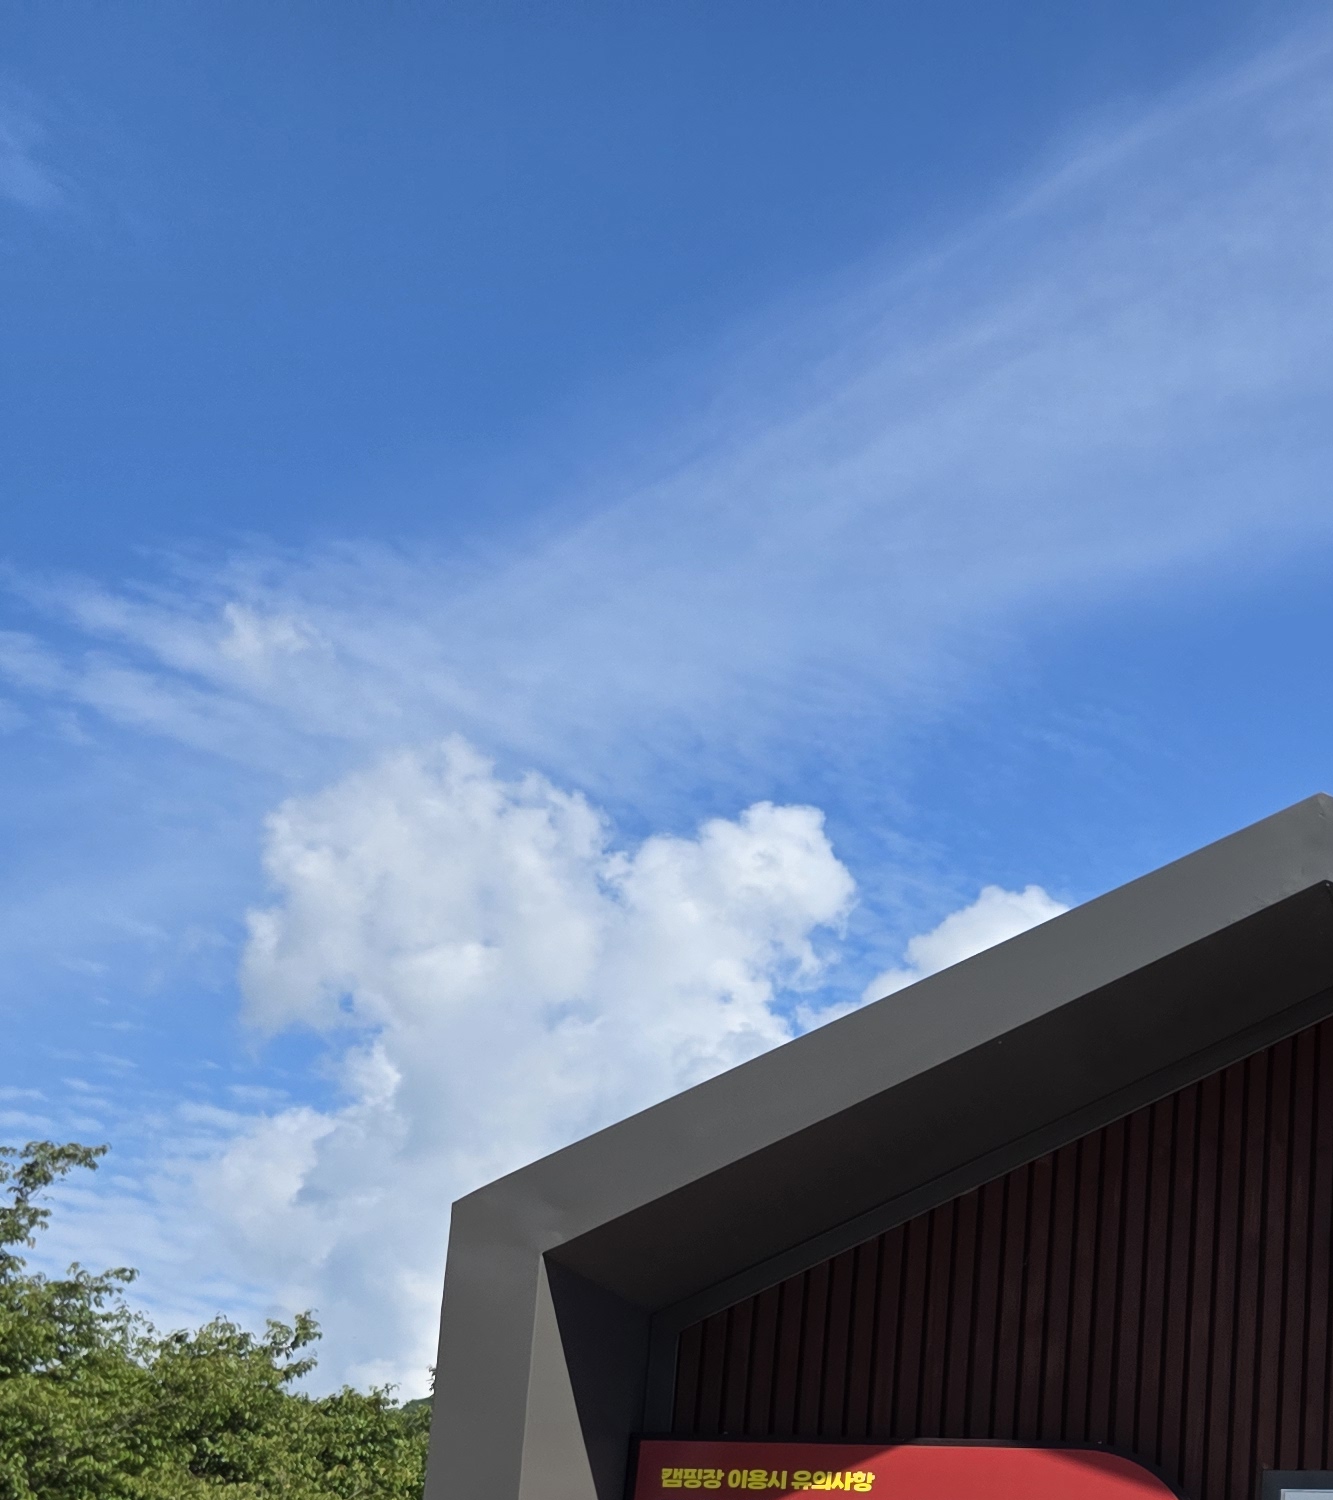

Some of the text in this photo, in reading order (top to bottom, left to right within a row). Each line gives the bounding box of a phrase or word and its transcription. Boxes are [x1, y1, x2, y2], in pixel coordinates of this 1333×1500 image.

[661, 1467, 876, 1493] 캠핑장 이용시 유의사항
